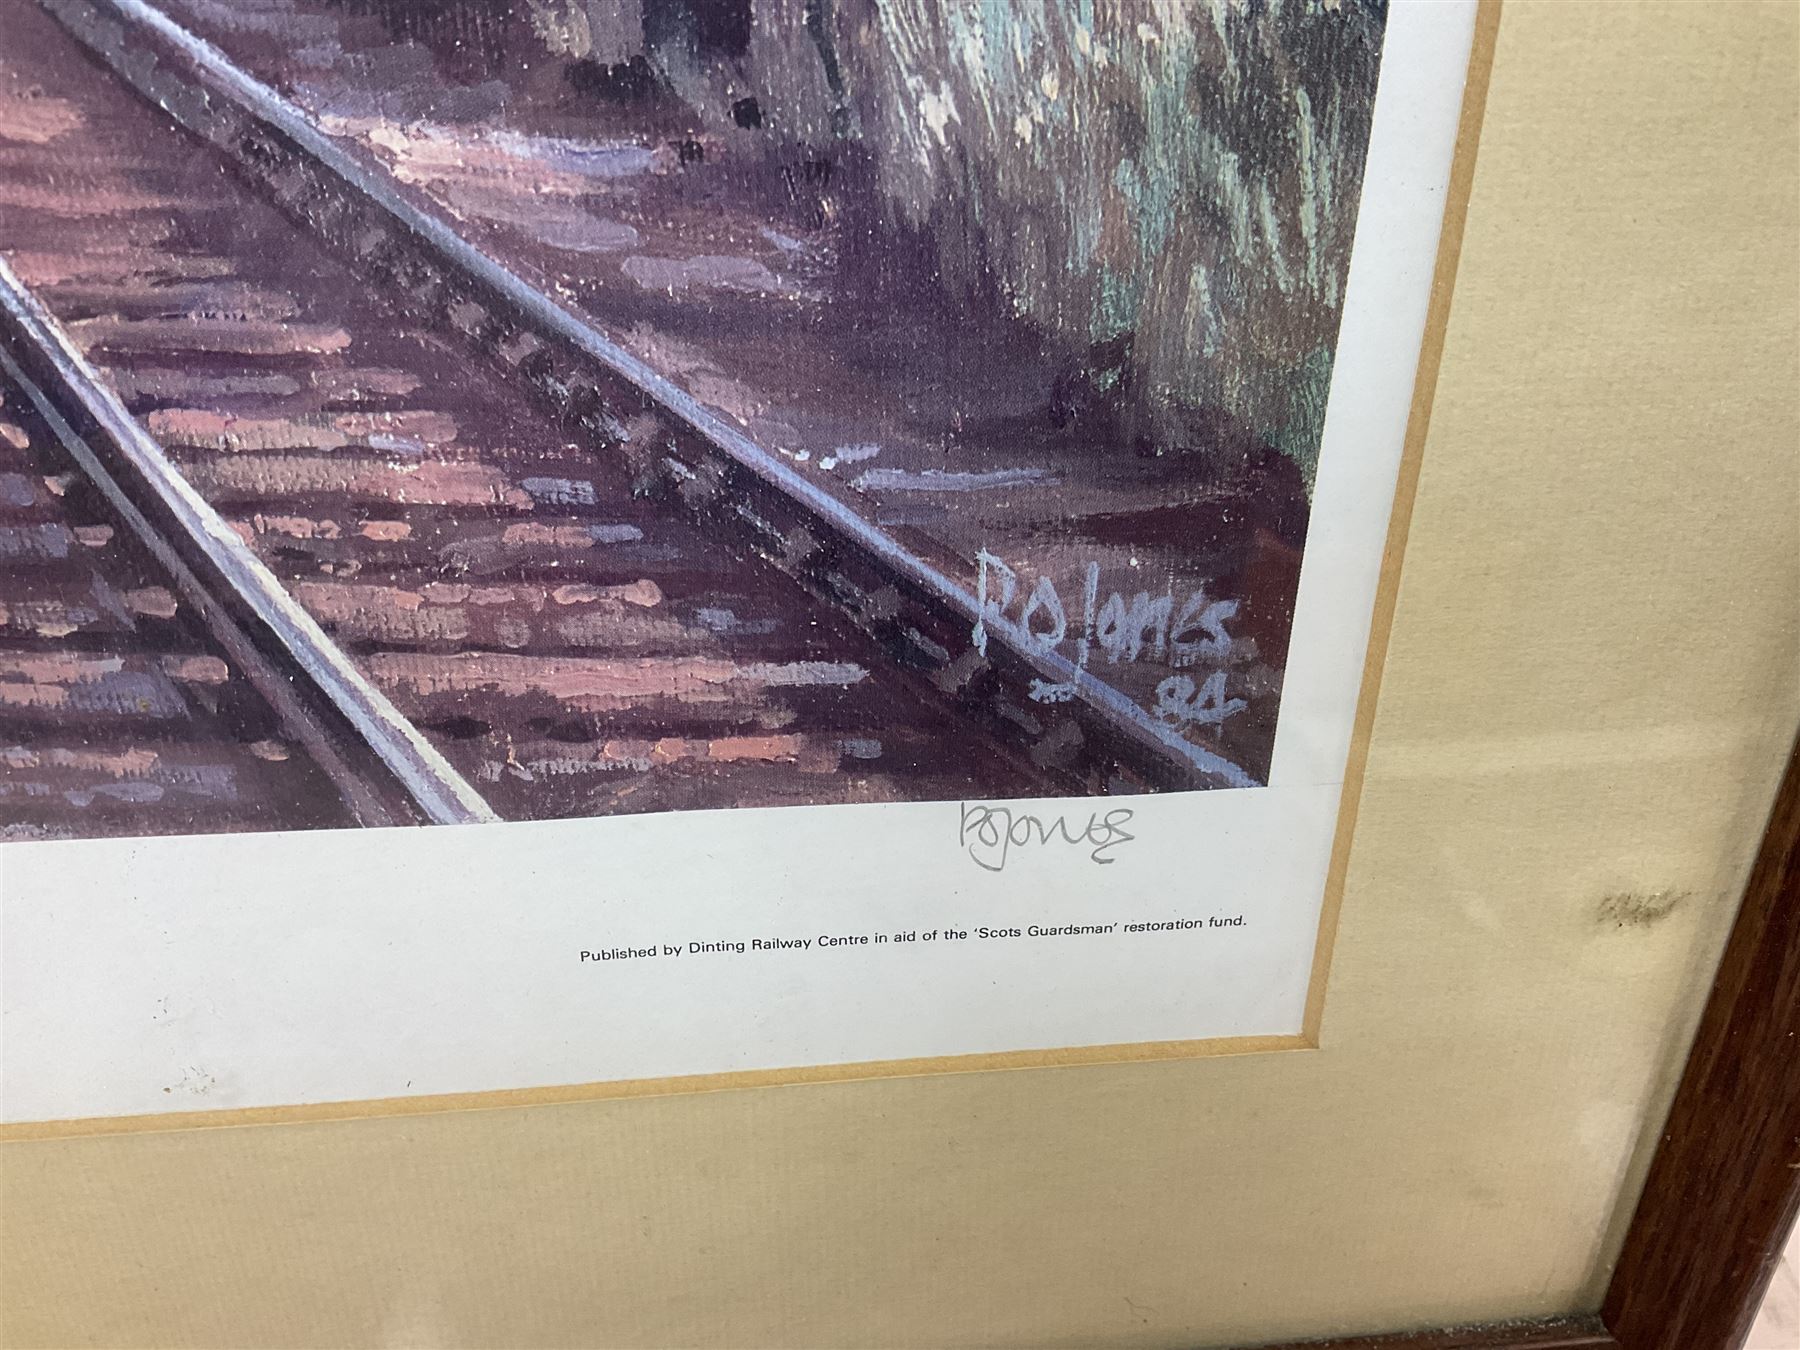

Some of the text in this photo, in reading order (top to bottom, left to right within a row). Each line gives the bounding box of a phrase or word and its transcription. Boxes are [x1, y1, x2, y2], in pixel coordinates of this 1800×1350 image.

[580, 944, 657, 963] Published
[663, 944, 683, 958] by
[688, 939, 745, 954] Dinting
[751, 937, 812, 951] Railway
[817, 935, 869, 948] Centre
[874, 932, 888, 944] in
[893, 930, 916, 943] aid
[921, 929, 938, 942] of
[943, 926, 968, 941] the
[1123, 918, 1203, 933] restoration
[1208, 914, 1247, 928] fund.
